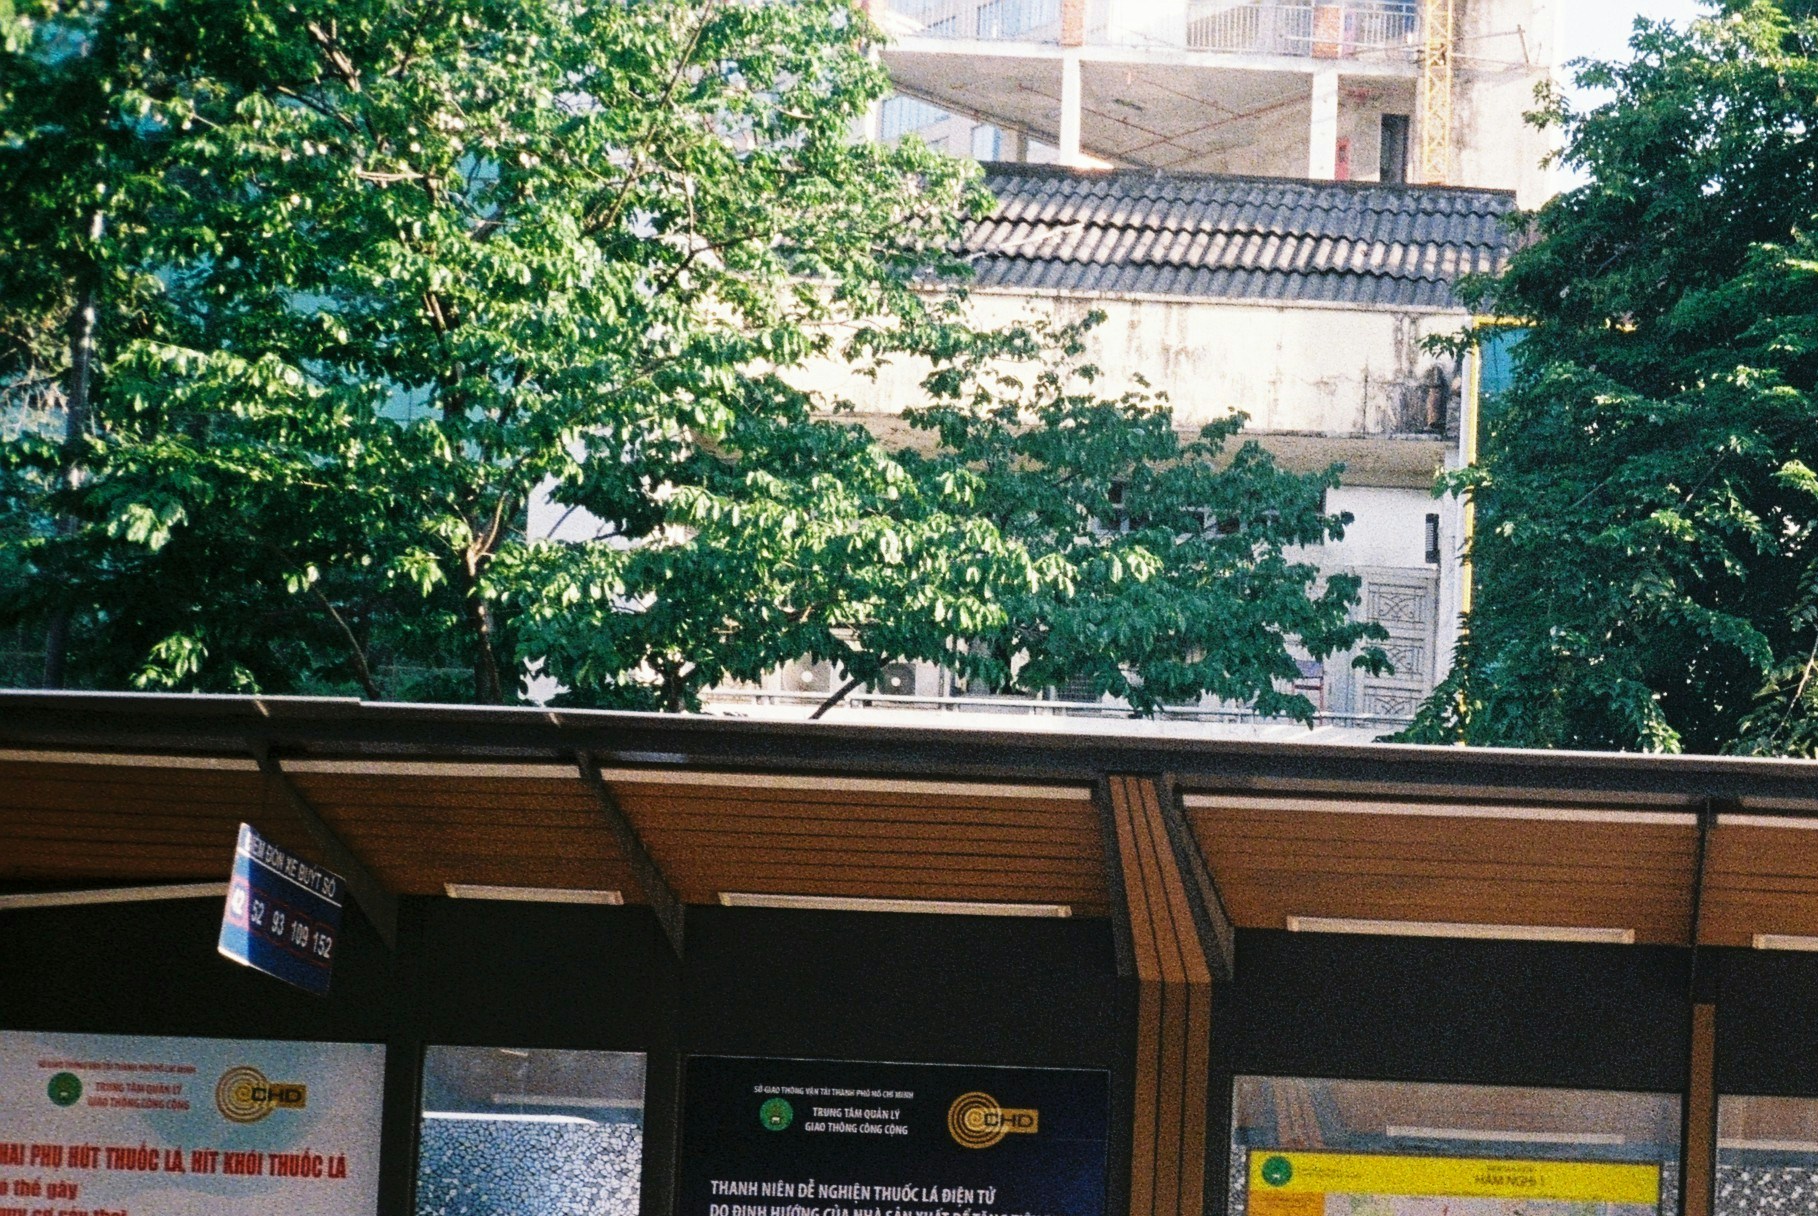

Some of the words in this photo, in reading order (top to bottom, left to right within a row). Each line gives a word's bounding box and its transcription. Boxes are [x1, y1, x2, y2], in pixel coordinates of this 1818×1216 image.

[284, 855, 299, 878] XE
[251, 899, 265, 926] 52
[271, 910, 286, 936] 93
[291, 920, 309, 948] 109
[312, 931, 333, 959] 152
[251, 1087, 302, 1103] CHD
[812, 1106, 842, 1117] TRUNG
[984, 1111, 1034, 1128] CHD
[804, 1121, 826, 1132] GIAO
[828, 1122, 858, 1133] THÔNG
[859, 1122, 883, 1134] CÔNG
[30, 1144, 63, 1172] PHỤ
[67, 1142, 100, 1169] HÚT
[328, 1153, 347, 1179] LÁ
[711, 1180, 758, 1197] THANH
[761, 1180, 795, 1197] NIÊN
[798, 1179, 815, 1199] DỄ
[818, 1182, 870, 1204] NGHIỆN
[874, 1182, 919, 1202] THUỐC
[922, 1185, 938, 1203] LÁ
[942, 1185, 974, 1207] ĐIỆN
[977, 1186, 997, 1205] TỬ
